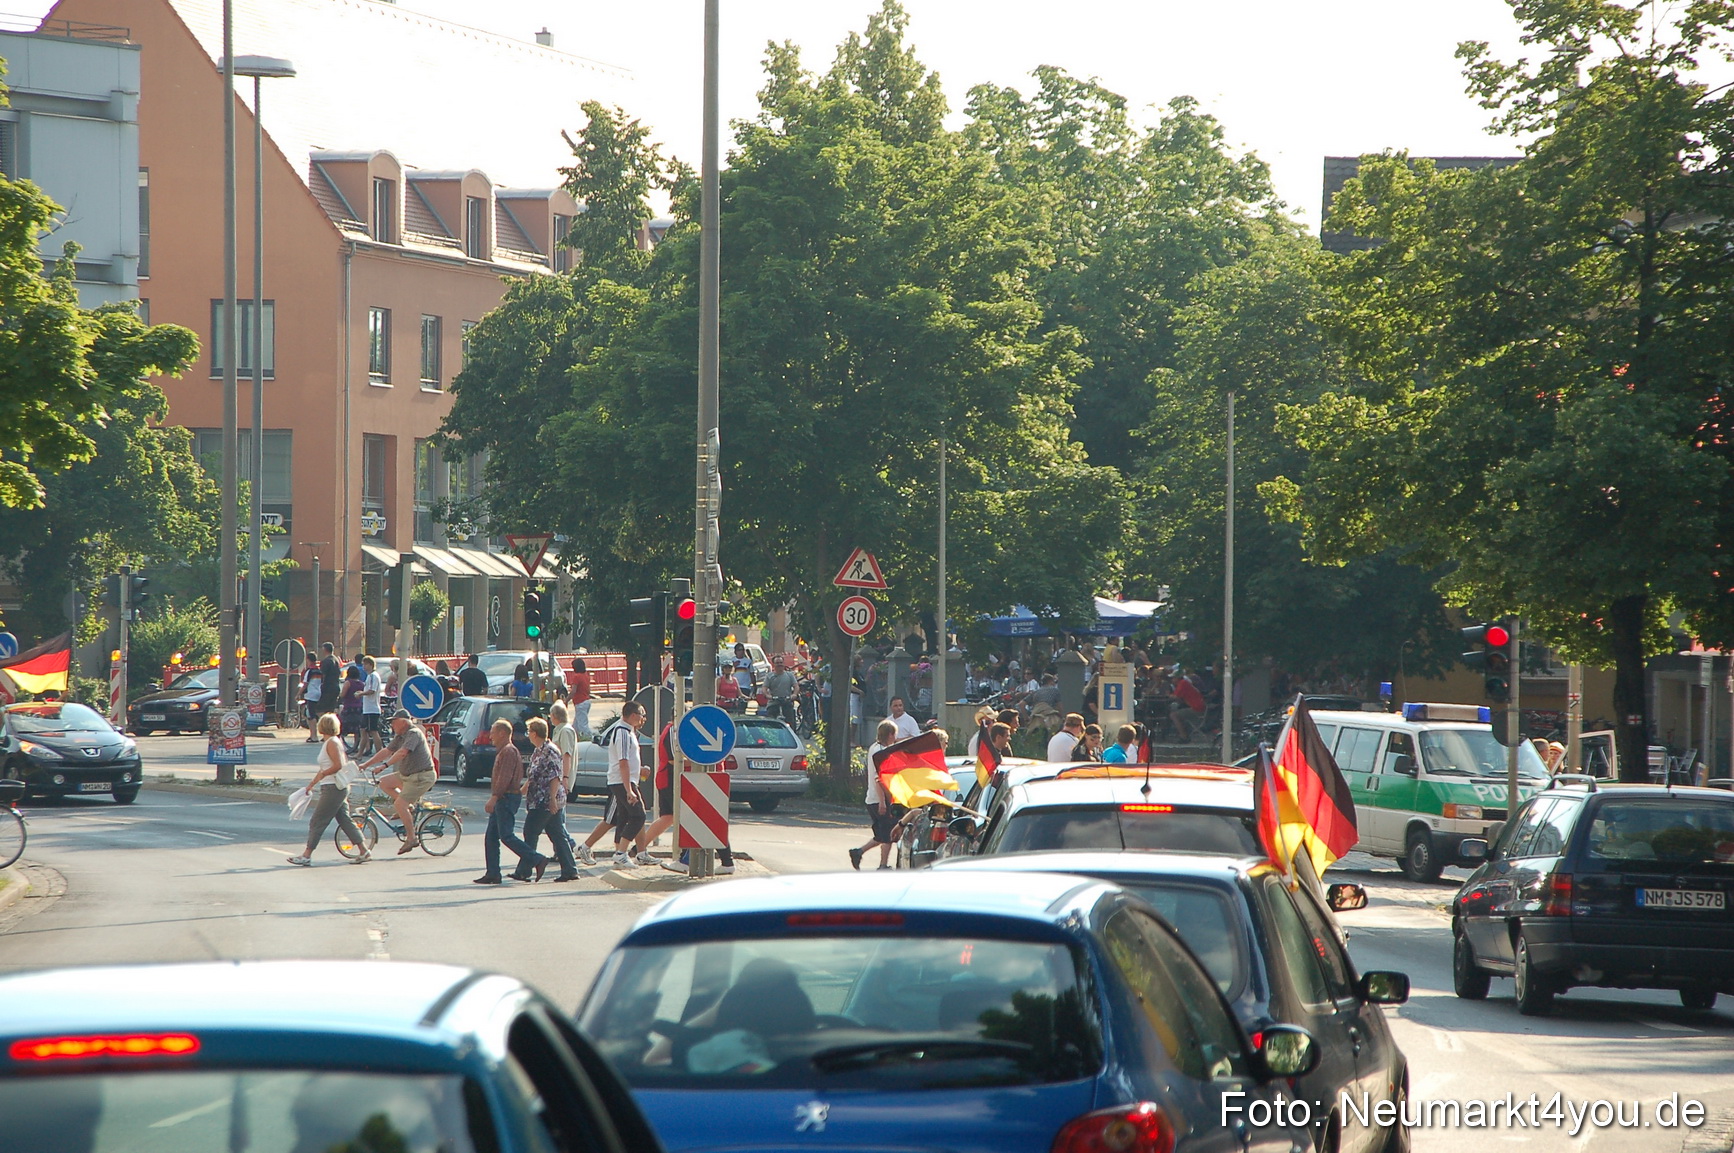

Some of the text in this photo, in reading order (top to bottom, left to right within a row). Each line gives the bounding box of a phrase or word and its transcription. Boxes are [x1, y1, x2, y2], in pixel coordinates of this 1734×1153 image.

[846, 607, 868, 625] 30
[1645, 891, 1724, 907] NM JS 578
